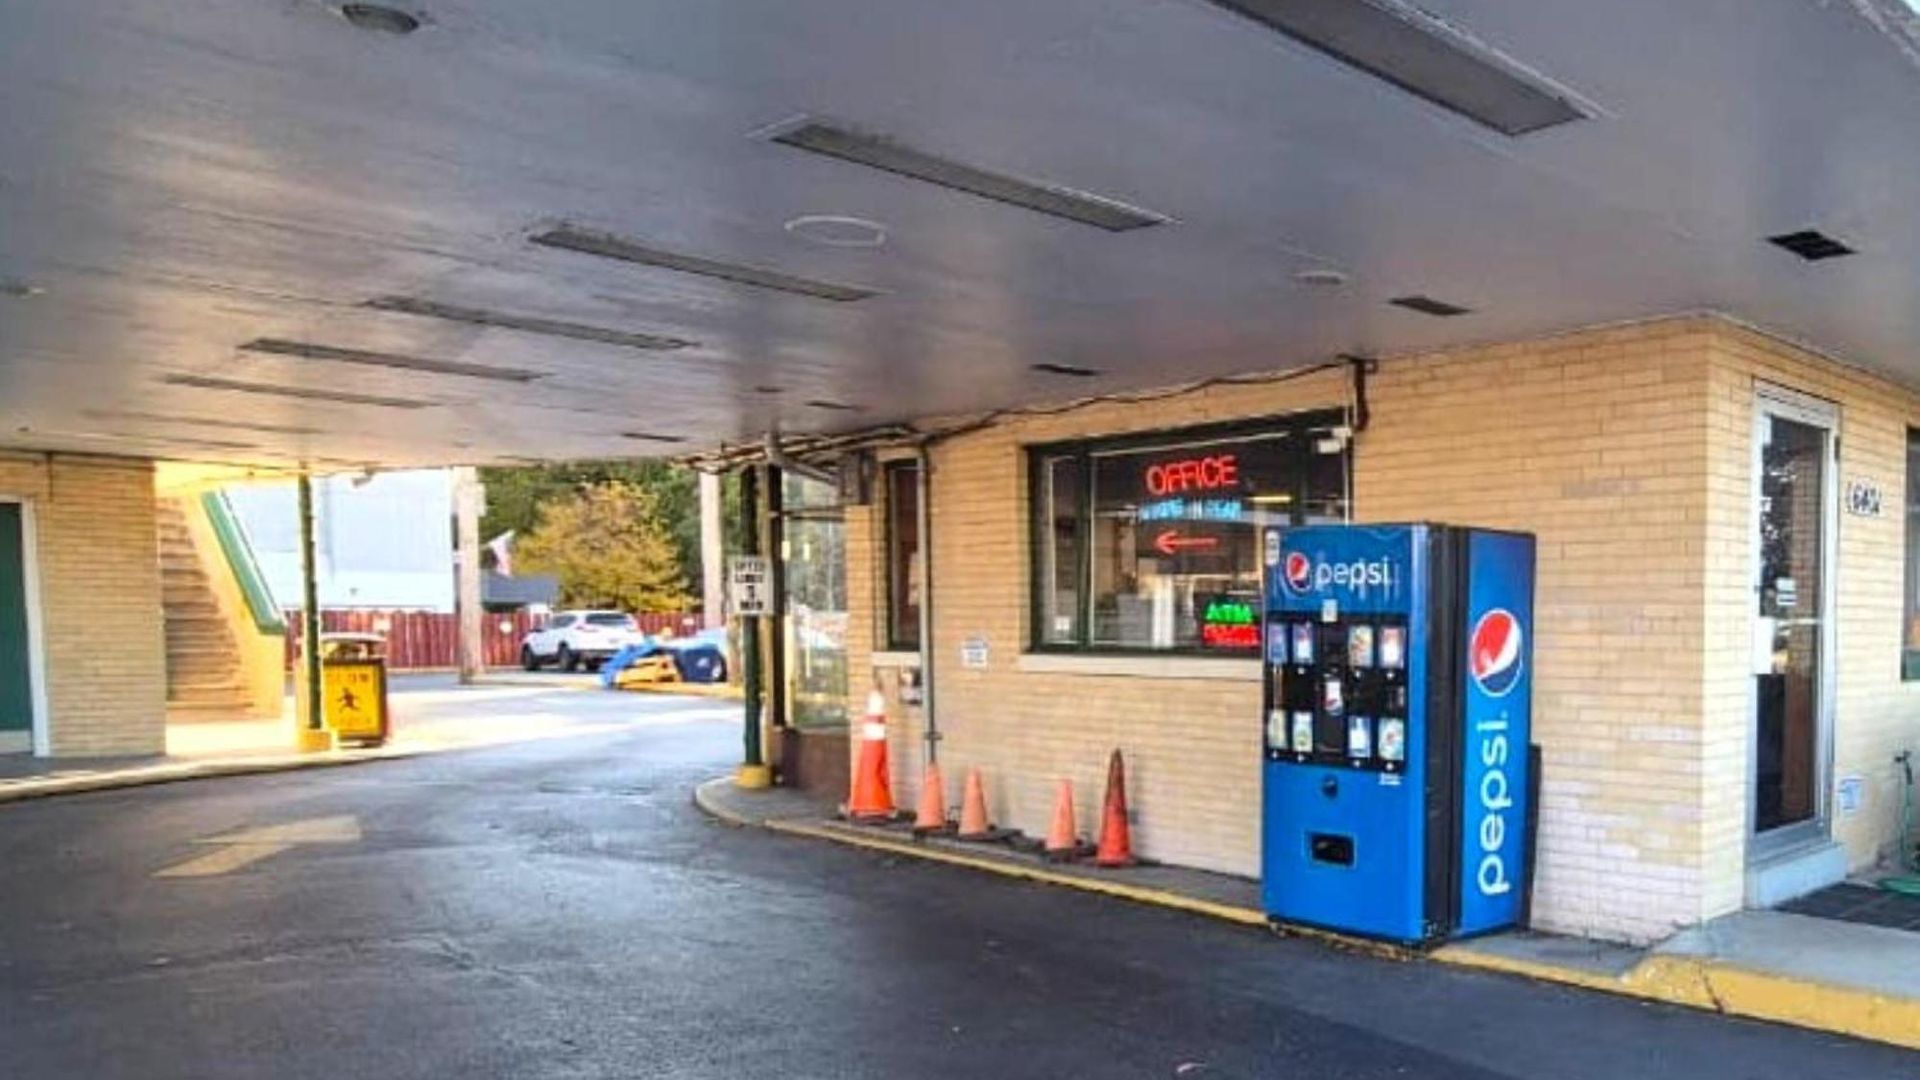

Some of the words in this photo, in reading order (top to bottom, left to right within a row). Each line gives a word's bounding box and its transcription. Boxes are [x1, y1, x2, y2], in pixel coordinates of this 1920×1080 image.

[1146, 455, 1239, 495] OFFICE
[1315, 555, 1390, 592] pepsi
[1206, 602, 1252, 622] ATM
[1476, 712, 1513, 896] pepsi
